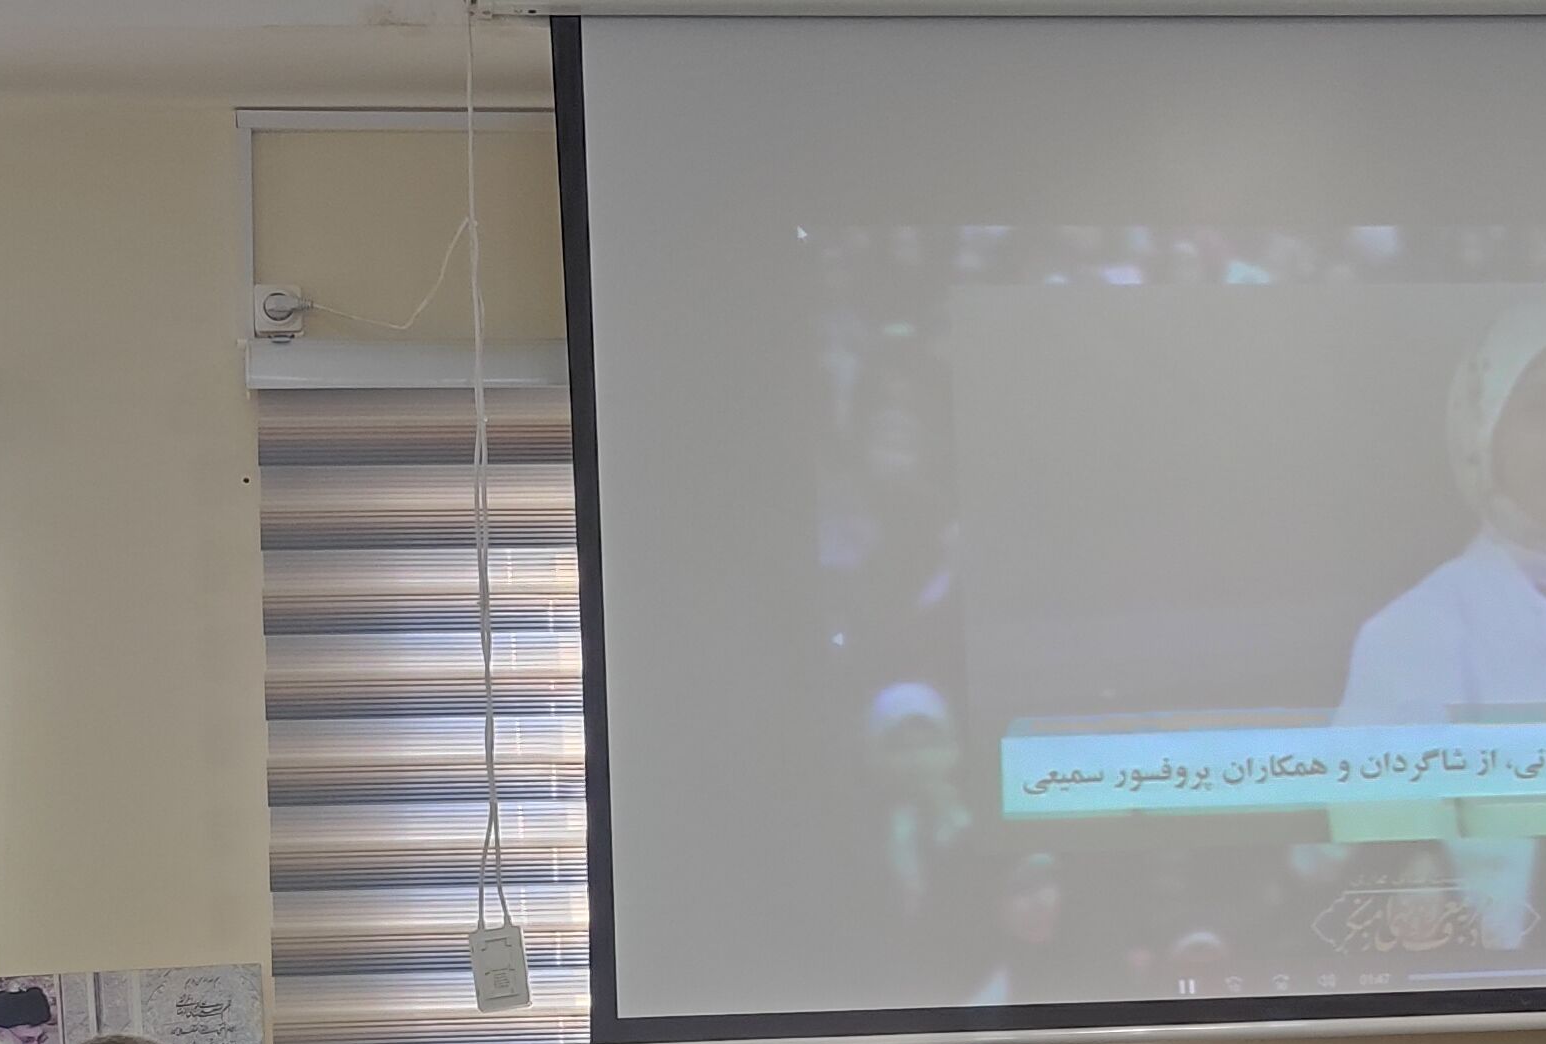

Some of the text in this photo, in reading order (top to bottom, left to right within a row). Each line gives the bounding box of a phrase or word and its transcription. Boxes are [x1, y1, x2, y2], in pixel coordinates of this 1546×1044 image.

[1113, 756, 1212, 793] پروفسور
[1222, 754, 1329, 787] همکاران
[1337, 761, 1351, 784] و
[1359, 747, 1468, 784] شاگردان
[1477, 748, 1497, 776] از
[1021, 765, 1104, 796] سمیعی
